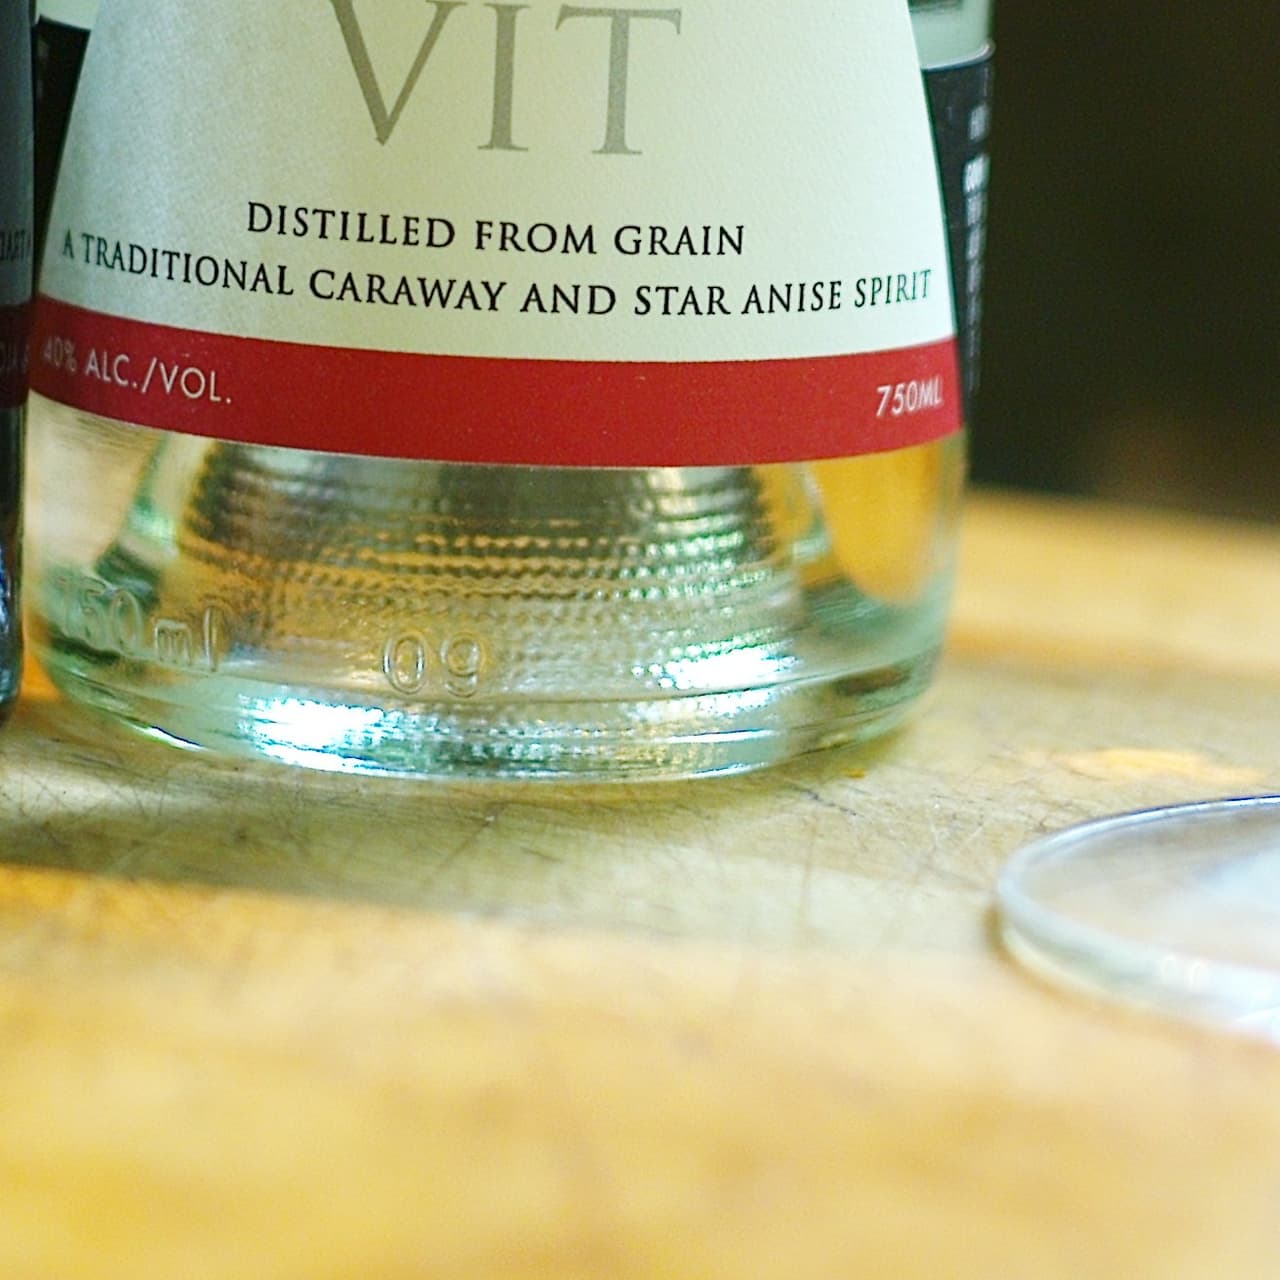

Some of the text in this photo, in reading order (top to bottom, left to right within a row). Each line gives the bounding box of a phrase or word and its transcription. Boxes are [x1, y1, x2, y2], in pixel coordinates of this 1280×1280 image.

[248, 202, 744, 256] DISTILLED FROM GRAIN
[63, 229, 74, 258] A
[83, 233, 294, 296] TRADITIONAL
[309, 269, 506, 311] CARAWAY
[520, 283, 616, 315] AND
[634, 286, 731, 316] STAR
[741, 280, 842, 315] ANISE
[854, 269, 931, 308] SPIRIT
[876, 376, 943, 417] 750ML
[381, 631, 483, 698] 09
